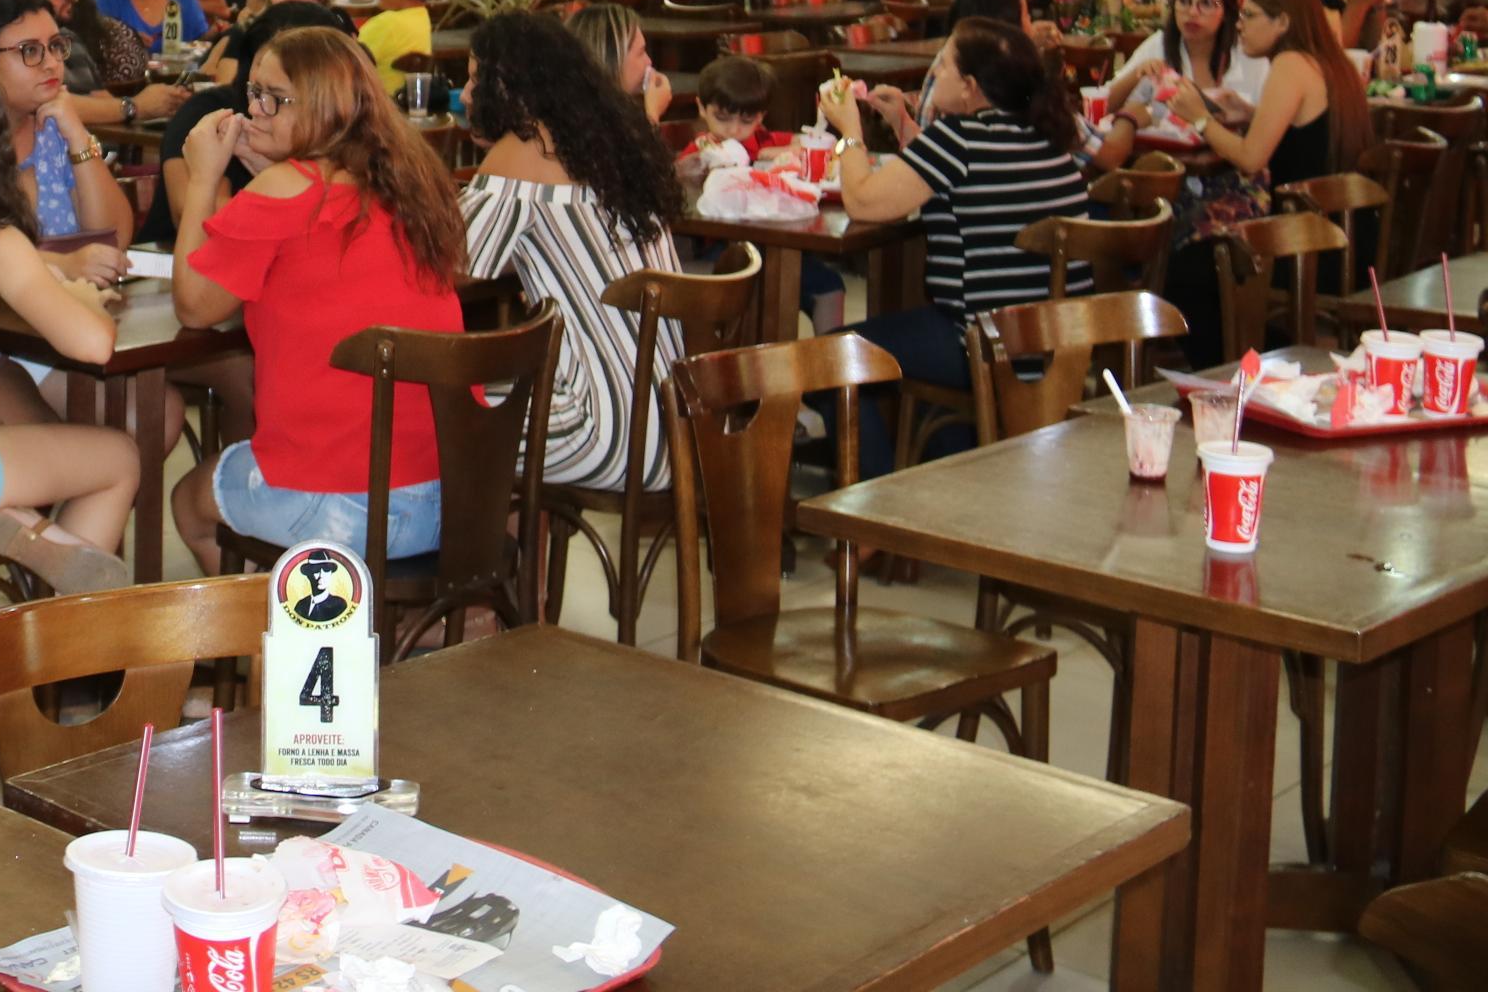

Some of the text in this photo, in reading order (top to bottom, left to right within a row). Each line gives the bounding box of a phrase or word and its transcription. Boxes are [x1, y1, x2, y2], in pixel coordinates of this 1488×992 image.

[165, 22, 178, 40] 20
[283, 603, 304, 625] DON
[299, 646, 339, 723] 4
[293, 734, 345, 746] APROVEITE:
[278, 748, 360, 757] FORNO A LENHA E MASSA
[291, 758, 348, 766] FRESCA TODO DIA
